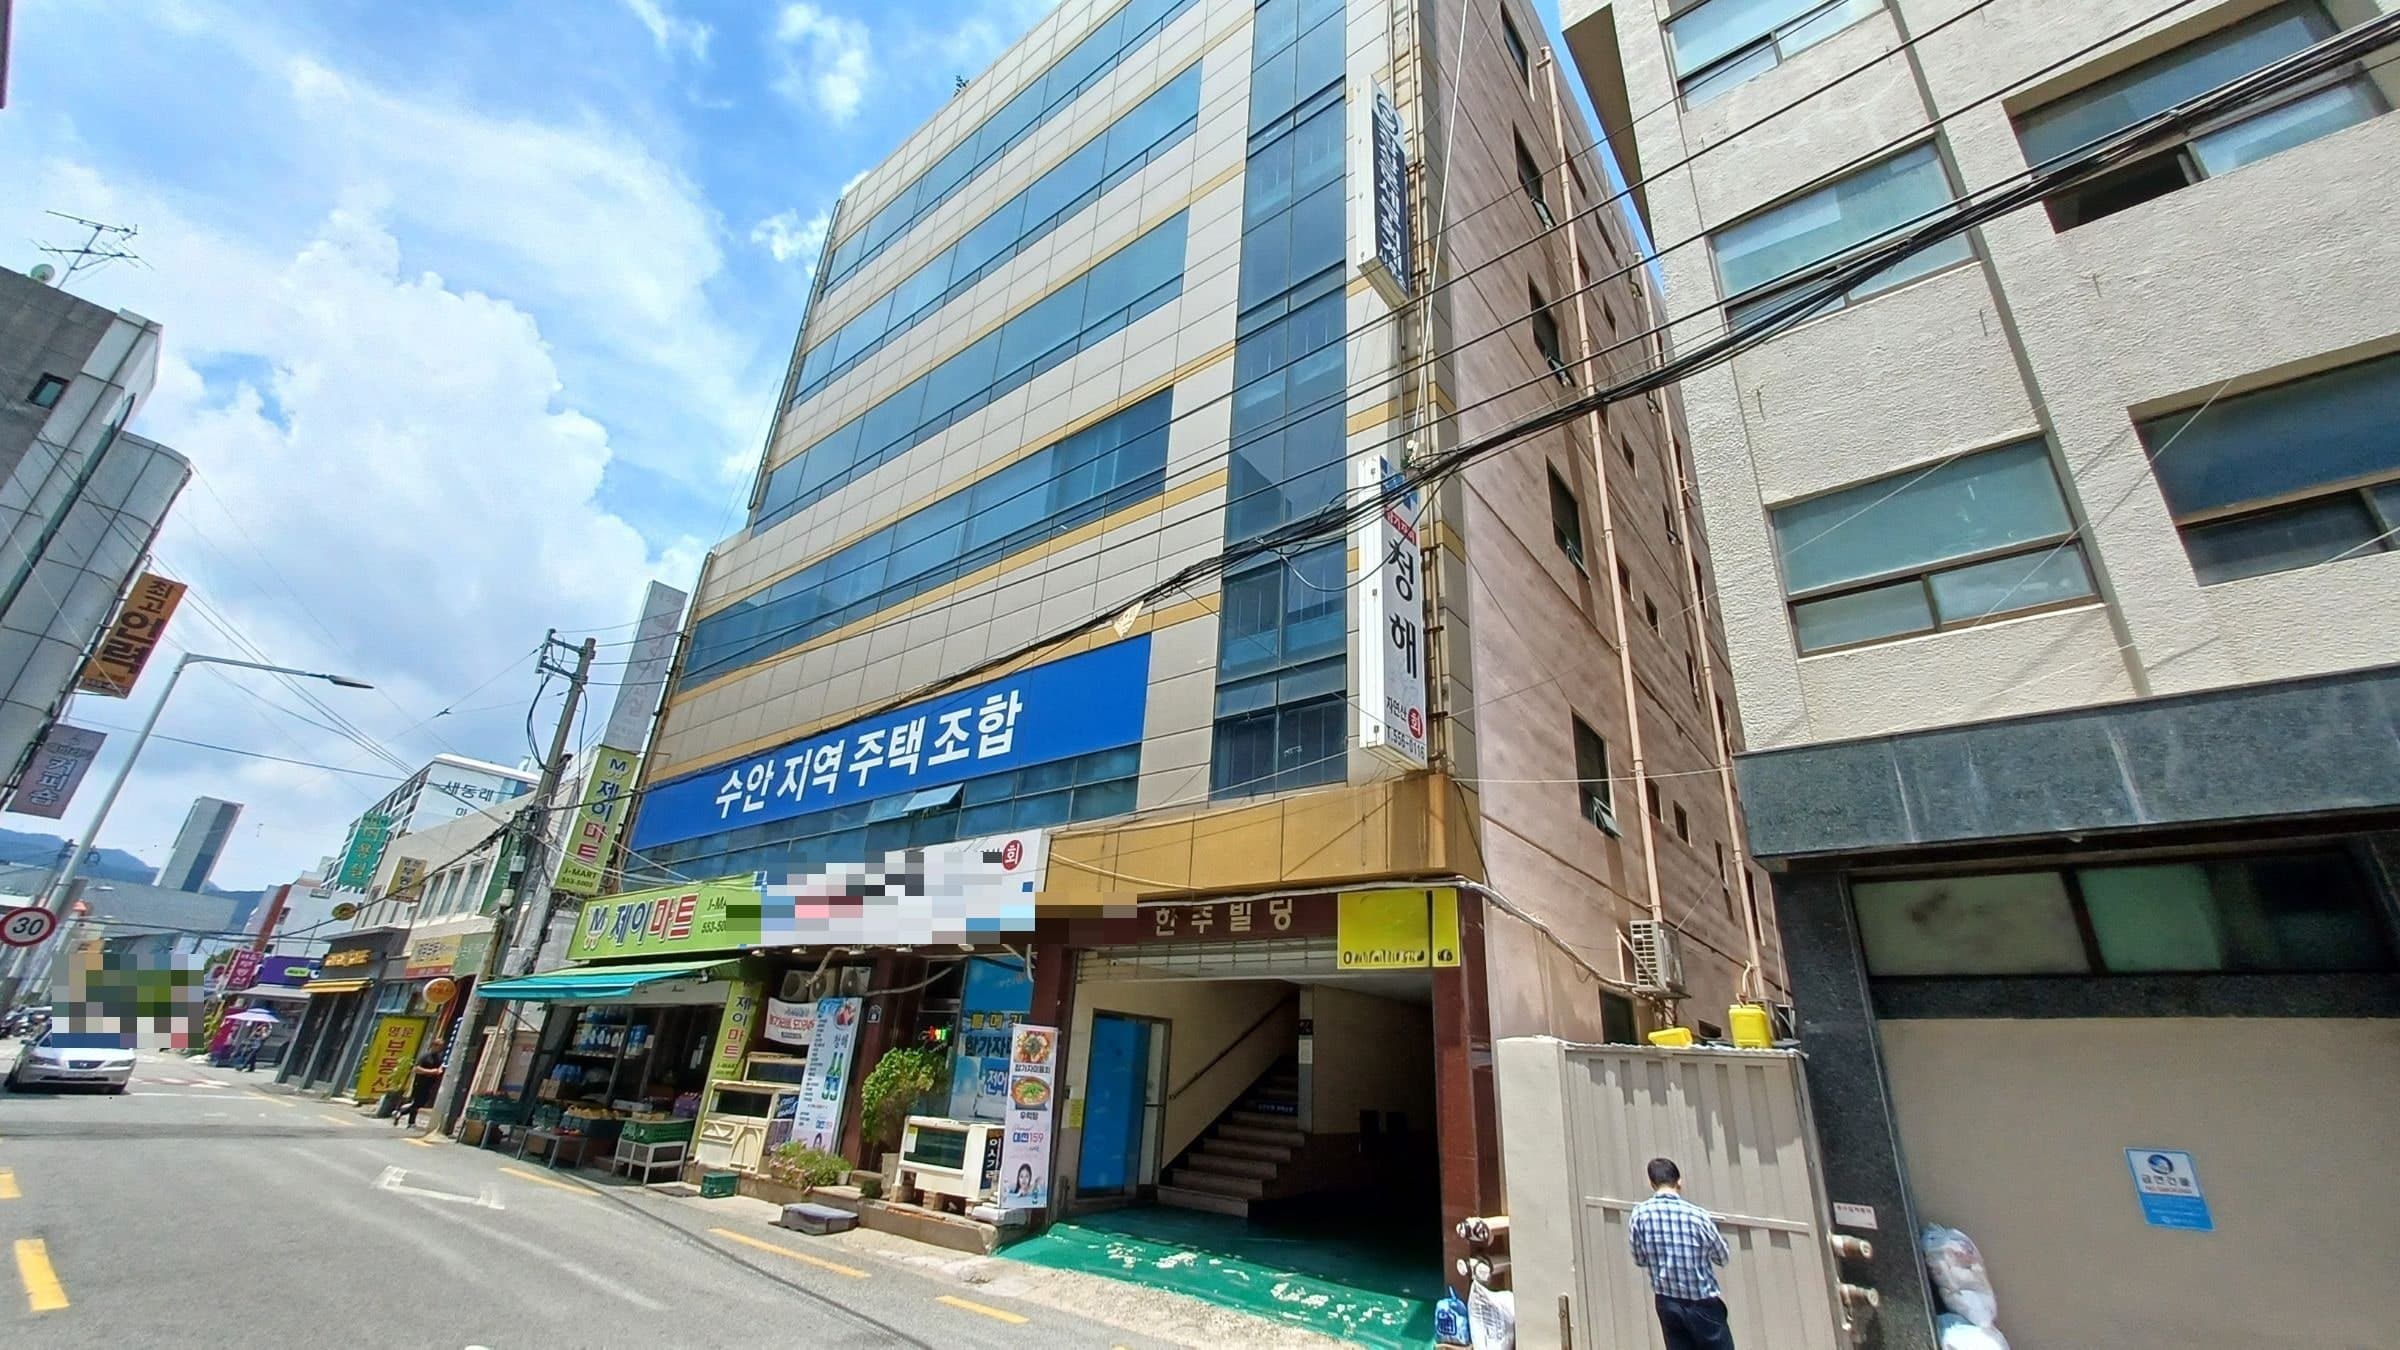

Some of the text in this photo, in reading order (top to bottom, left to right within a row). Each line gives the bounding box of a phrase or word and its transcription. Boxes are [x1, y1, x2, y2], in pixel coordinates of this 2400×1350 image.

[1387, 538, 1417, 680] 청해
[1386, 696, 1407, 722] 자연산
[715, 689, 1024, 819] 수안 지역 주택 조합
[577, 779, 620, 865] 제이마트
[563, 866, 598, 880] J-MART
[12, 916, 44, 936] 30
[609, 893, 699, 945] 제이마트
[1155, 898, 1293, 937] 한주빌딩
[722, 996, 753, 1059] 제이마트
